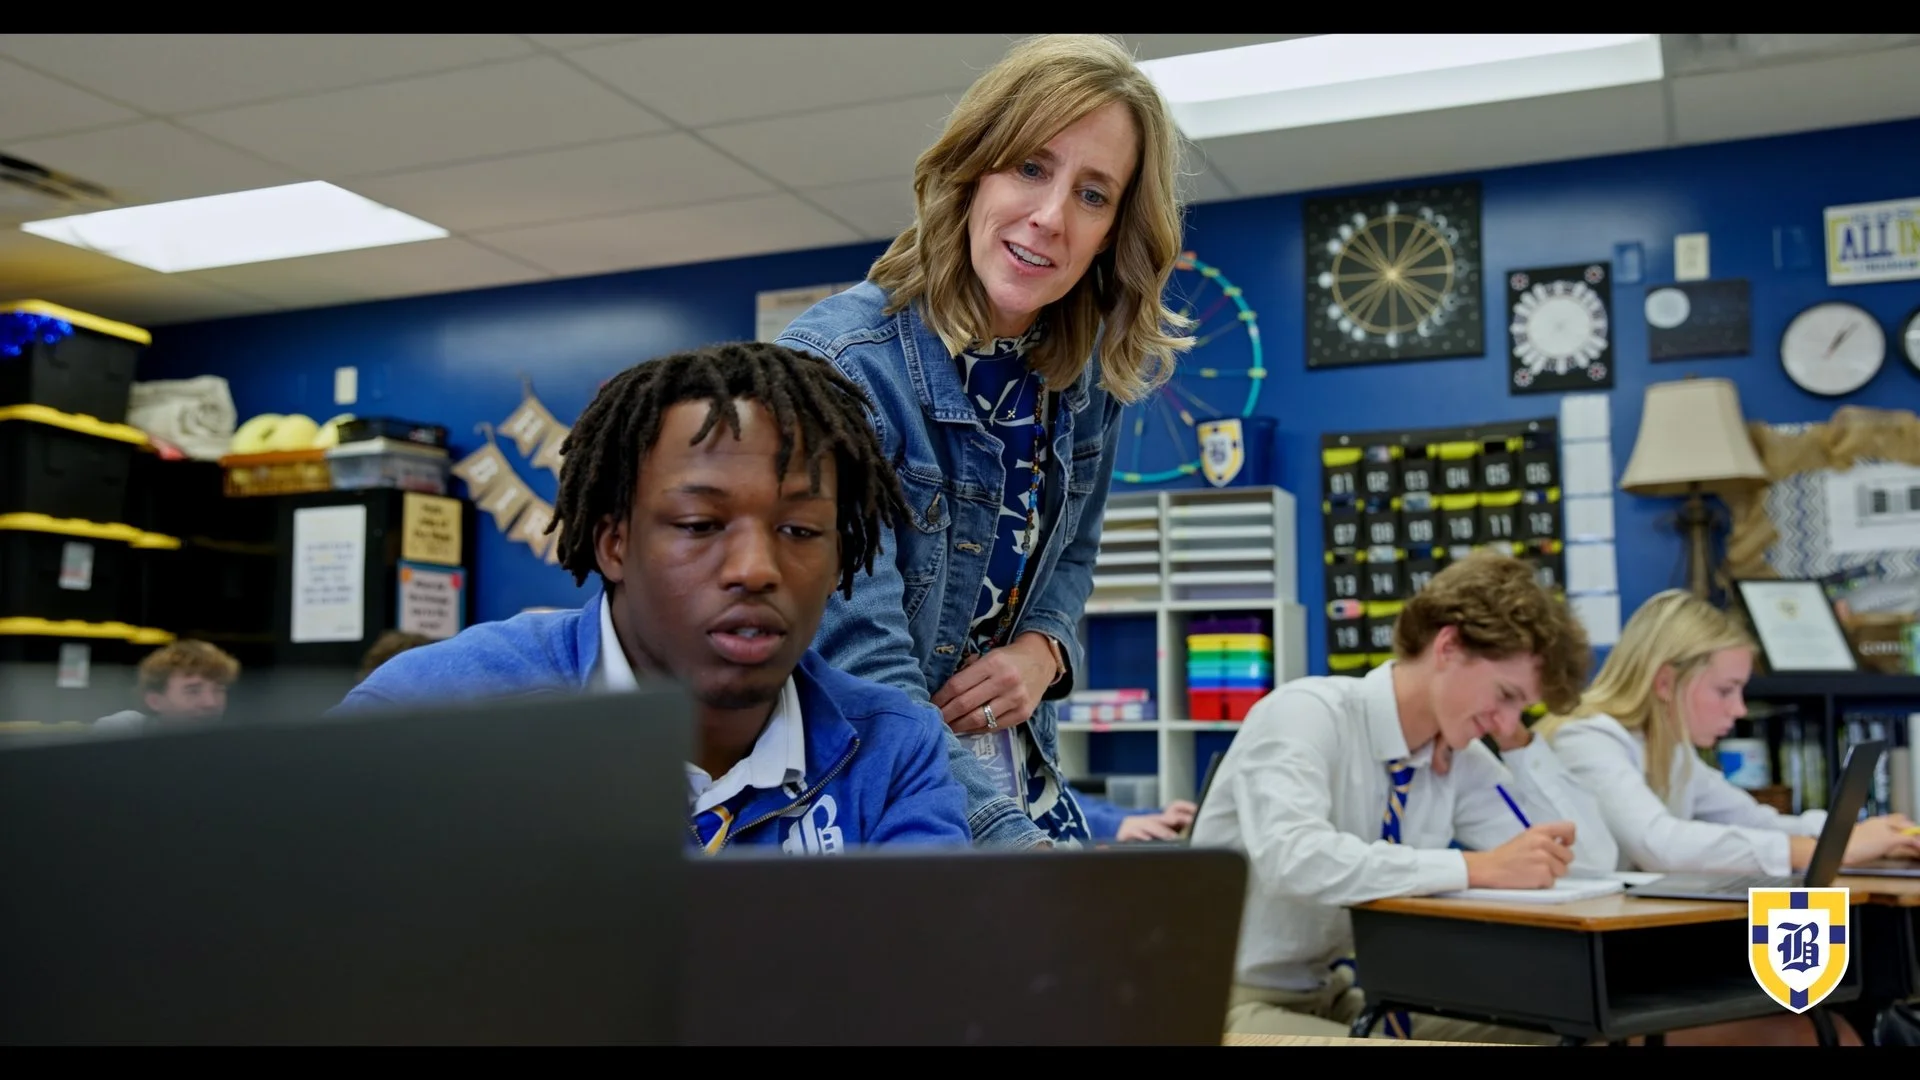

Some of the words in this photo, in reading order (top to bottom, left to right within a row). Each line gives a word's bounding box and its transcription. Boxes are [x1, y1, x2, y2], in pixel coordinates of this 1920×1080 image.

[1838, 221, 1895, 263] ALL
[1330, 473, 1355, 495] 01
[1366, 471, 1390, 493] 02
[1404, 470, 1429, 491] 03
[1445, 467, 1470, 489] 04
[1485, 463, 1510, 486] 05
[1525, 462, 1551, 485] 06
[1333, 523, 1357, 545] 07
[1370, 521, 1395, 544] 08
[1408, 519, 1434, 542] 09
[1448, 517, 1473, 539] 10
[1489, 513, 1513, 536] 11
[1528, 512, 1553, 534] 12
[1333, 574, 1357, 597] 13
[1371, 573, 1394, 595] 14
